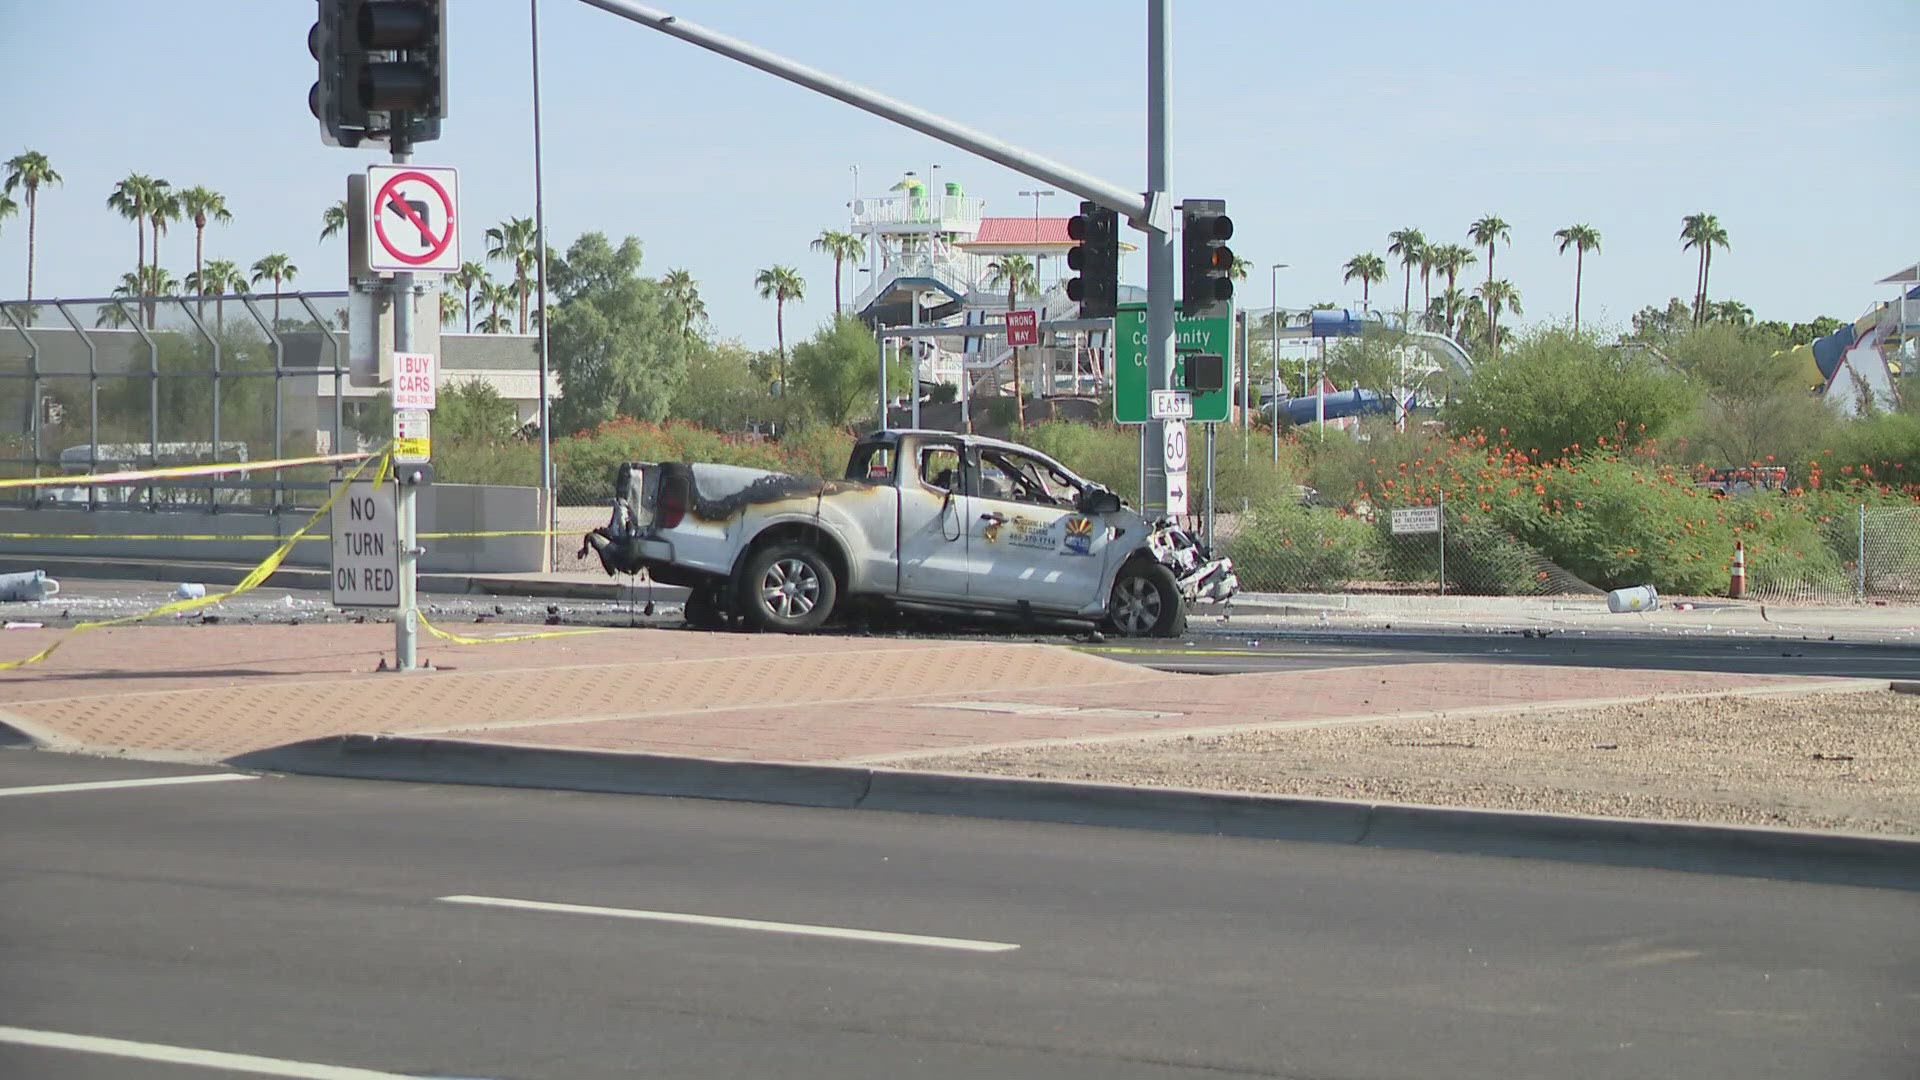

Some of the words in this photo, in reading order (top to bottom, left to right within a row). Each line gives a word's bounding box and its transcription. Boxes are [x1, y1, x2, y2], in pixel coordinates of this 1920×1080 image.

[1009, 315, 1033, 326] WRONG
[1014, 331, 1029, 341] WAY
[1132, 329, 1210, 346] Counity
[406, 357, 429, 373] BUY
[399, 375, 430, 392] CARS
[1158, 396, 1186, 412] EAST
[1166, 431, 1184, 460] 60
[350, 497, 375, 520] NO
[344, 532, 384, 556] TURN
[338, 567, 356, 591] ON
[364, 568, 394, 592] RED
